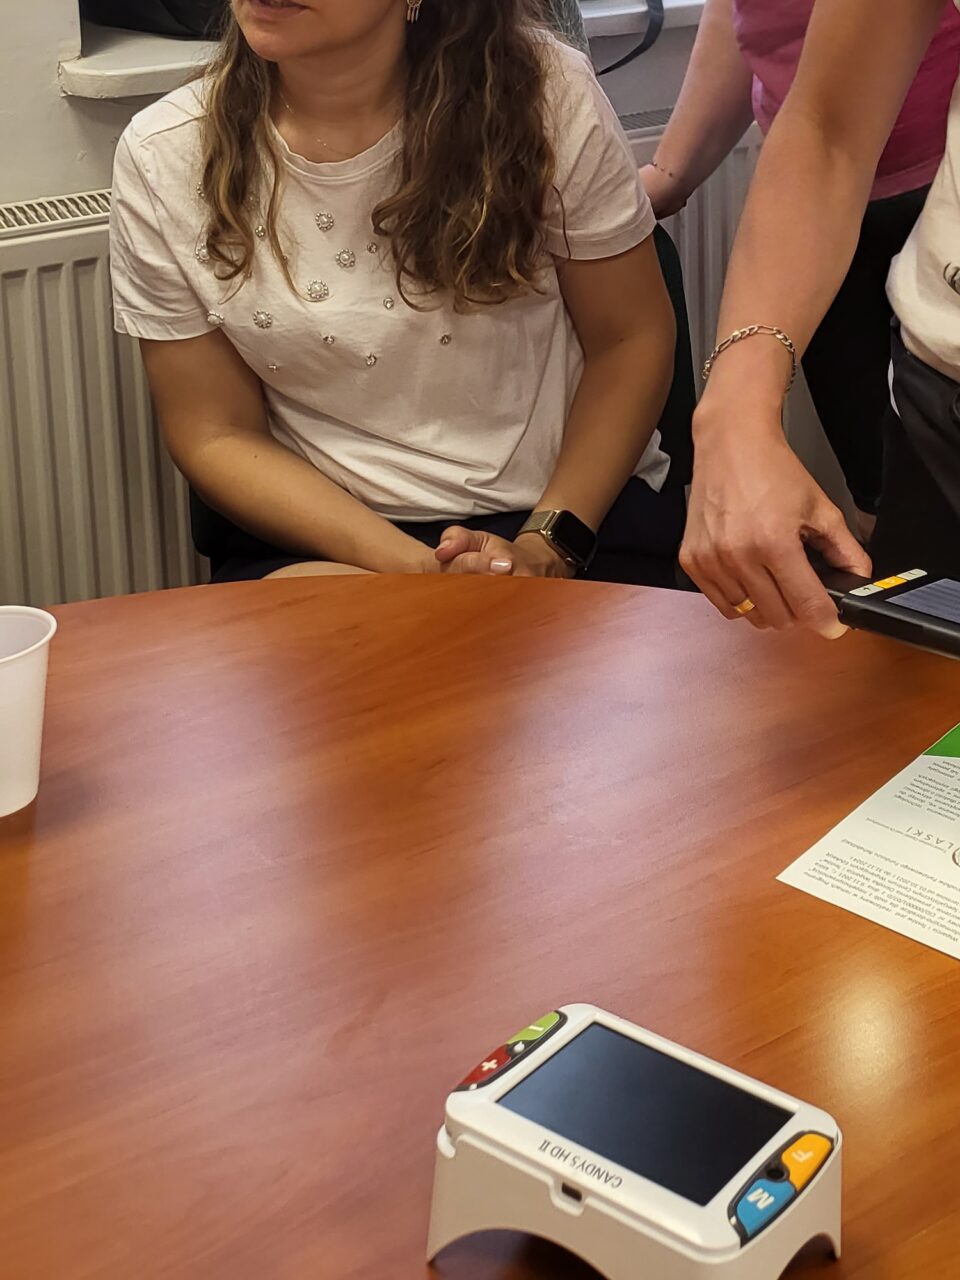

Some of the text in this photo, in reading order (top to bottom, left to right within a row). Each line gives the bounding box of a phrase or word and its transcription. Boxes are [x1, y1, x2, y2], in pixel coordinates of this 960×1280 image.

[550, 1145, 571, 1162] HD
[791, 1149, 814, 1163] F
[746, 1187, 775, 1210] M
